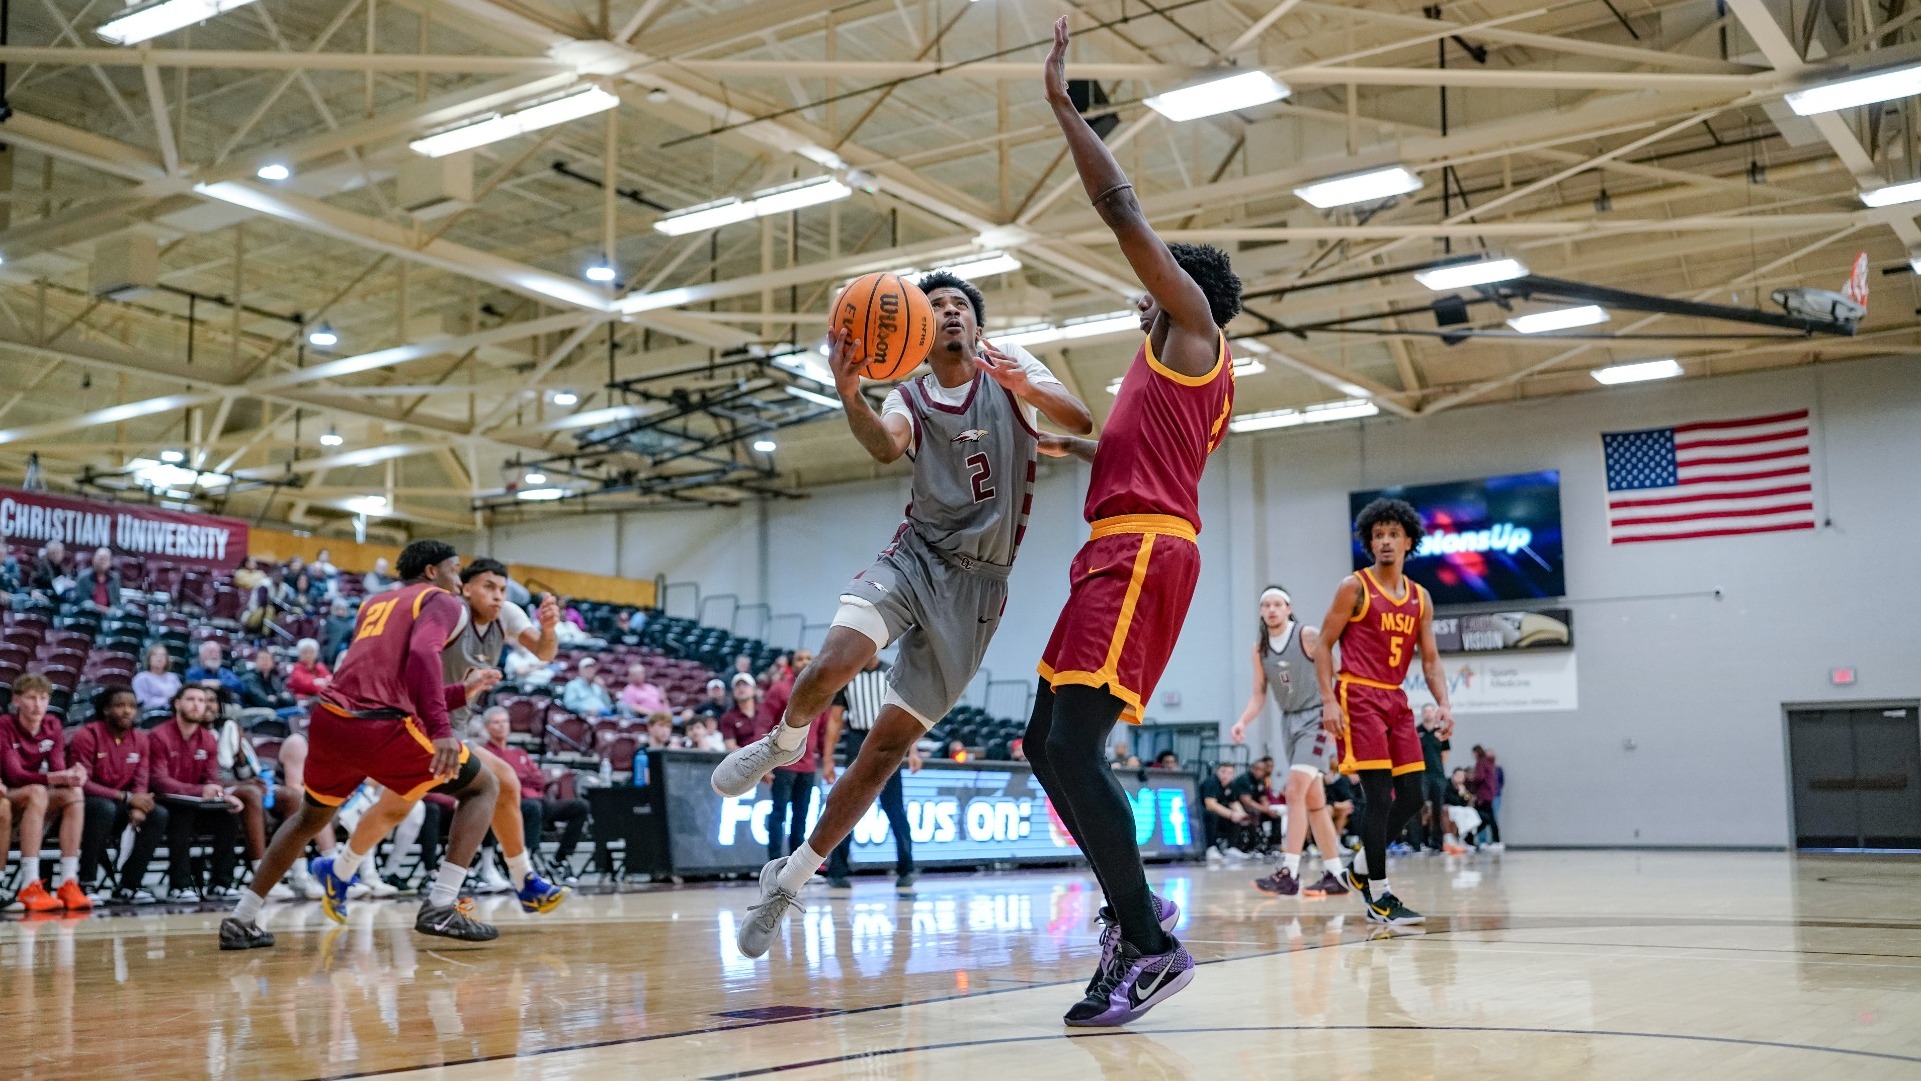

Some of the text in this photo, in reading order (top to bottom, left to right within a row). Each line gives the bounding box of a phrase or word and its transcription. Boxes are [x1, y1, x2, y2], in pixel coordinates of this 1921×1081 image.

[873, 294, 899, 364] Wilson
[965, 451, 996, 504] 2
[0, 498, 230, 561] CHRISTIAN UNIVERSITY
[354, 597, 400, 642] 21
[1380, 612, 1416, 636] MSU
[1461, 631, 1504, 651] VISION
[1388, 636, 1404, 668] 5
[907, 801, 957, 842] us
[966, 799, 1031, 841] on:
